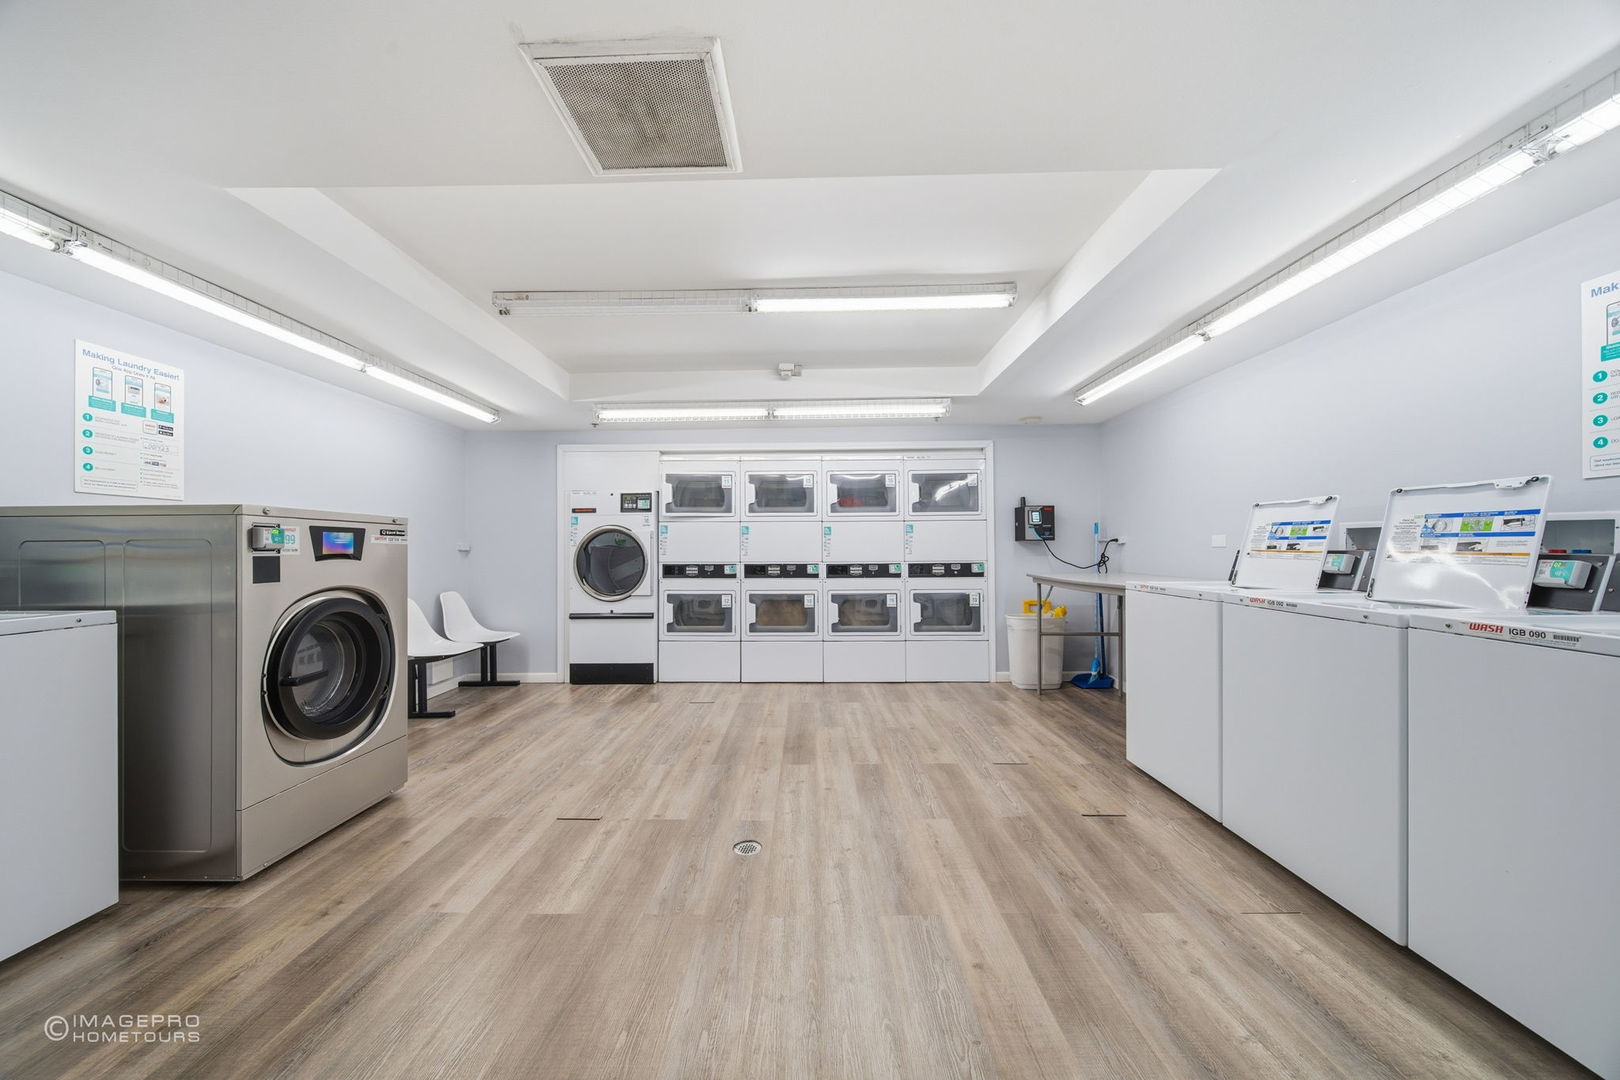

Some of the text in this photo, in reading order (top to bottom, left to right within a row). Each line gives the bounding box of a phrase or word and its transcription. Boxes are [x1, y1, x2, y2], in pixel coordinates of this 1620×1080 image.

[82, 349, 180, 381] Making Laundry Easier!
[1469, 622, 1546, 639] WASH IGB 090
